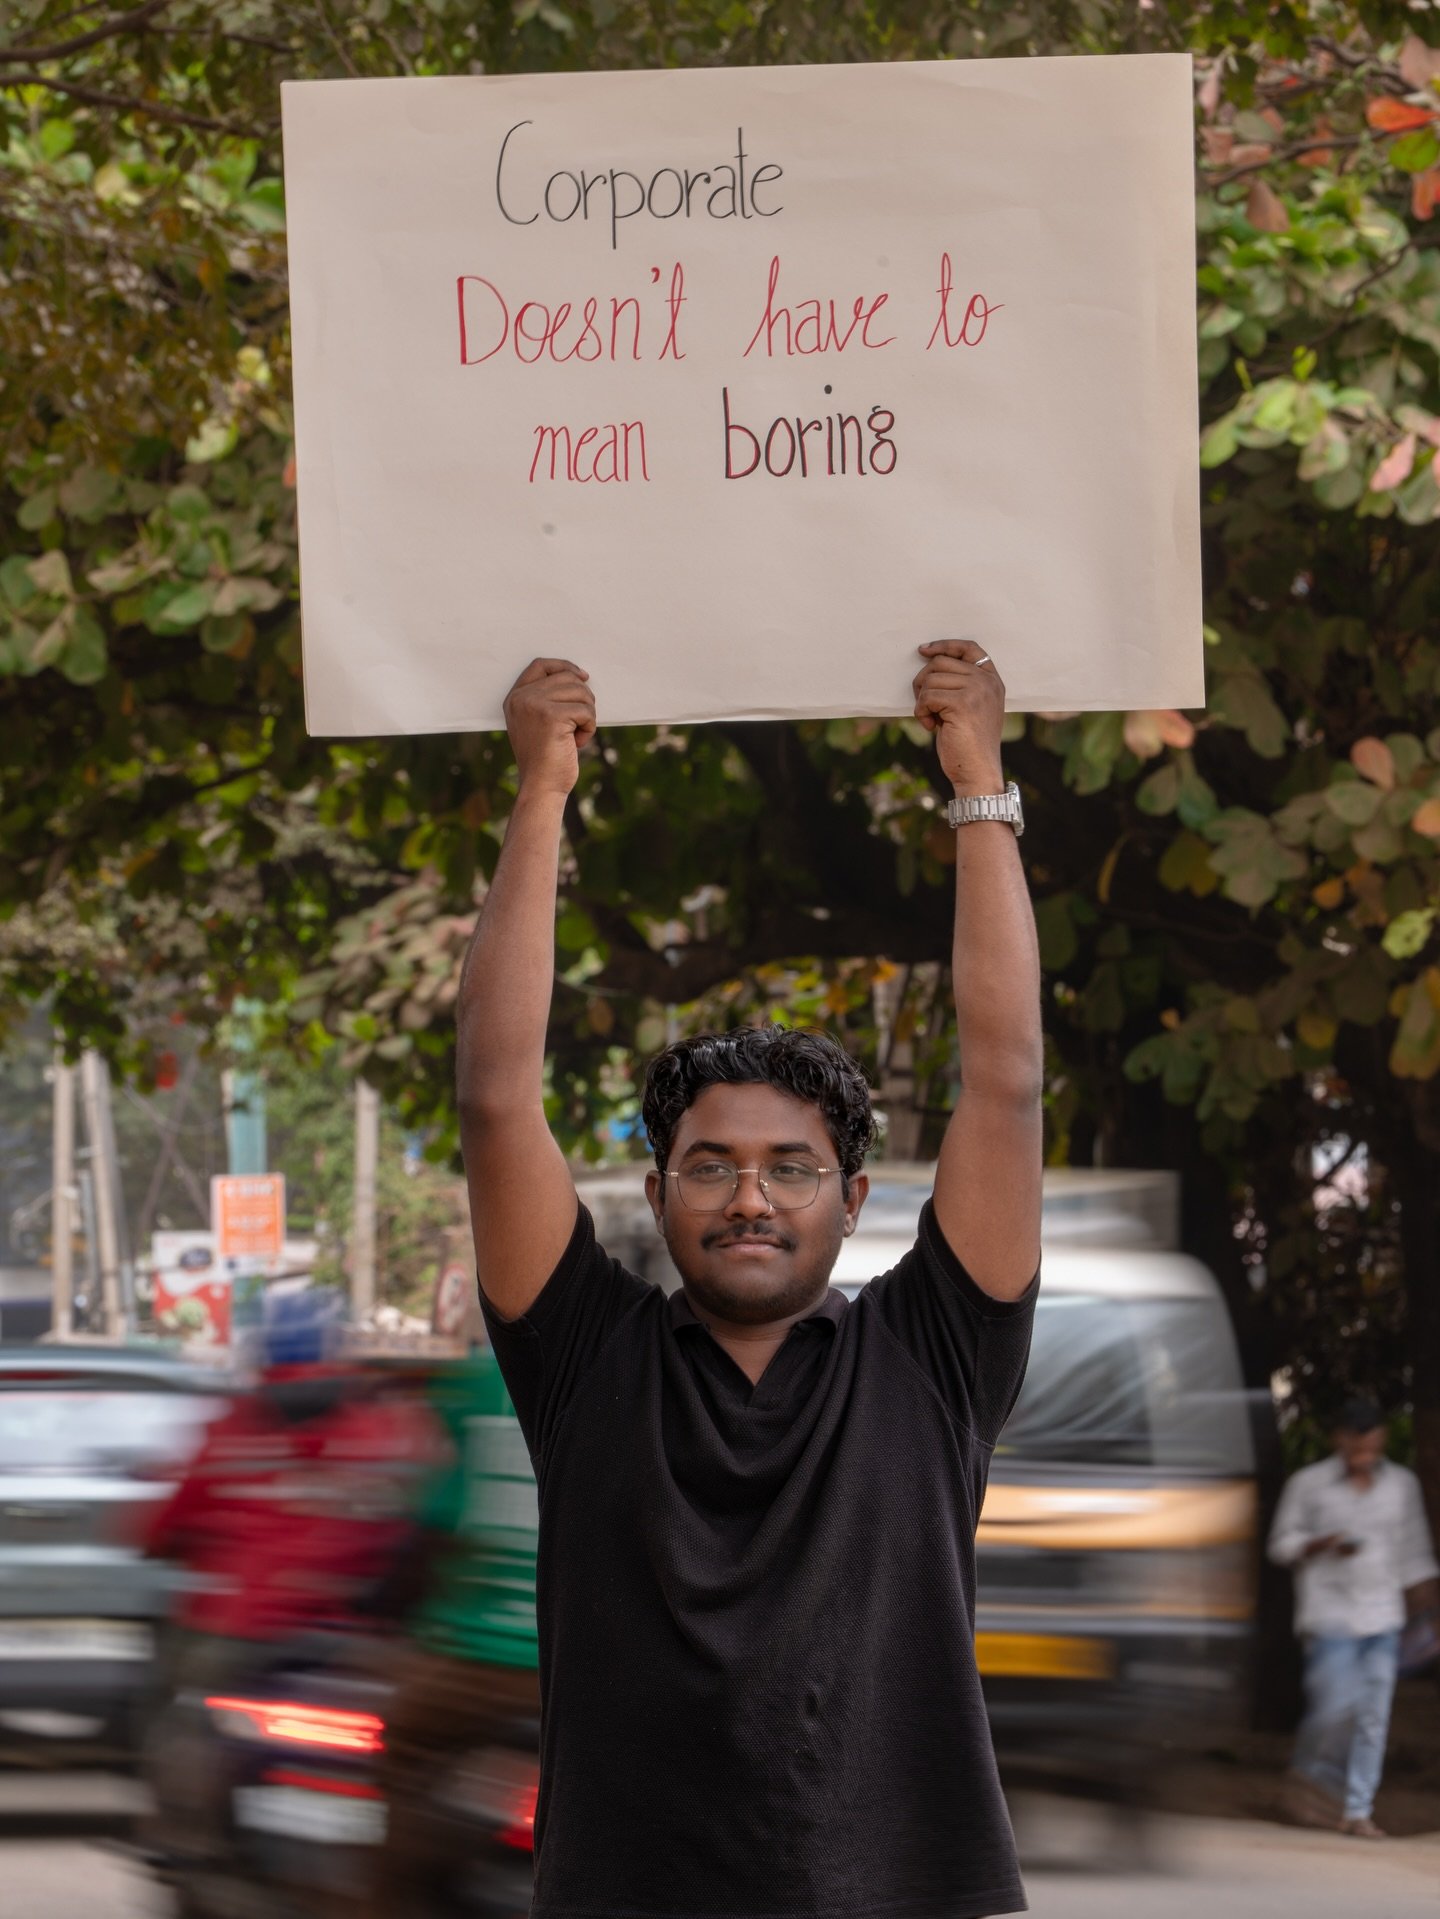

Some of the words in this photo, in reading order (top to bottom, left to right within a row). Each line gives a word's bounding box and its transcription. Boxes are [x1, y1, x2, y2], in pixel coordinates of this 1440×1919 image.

[496, 120, 785, 251] Corporate
[456, 261, 688, 366] Doesn't
[742, 255, 898, 358] have
[926, 251, 1005, 351] to
[529, 420, 651, 483] mean
[722, 384, 898, 480] boring
